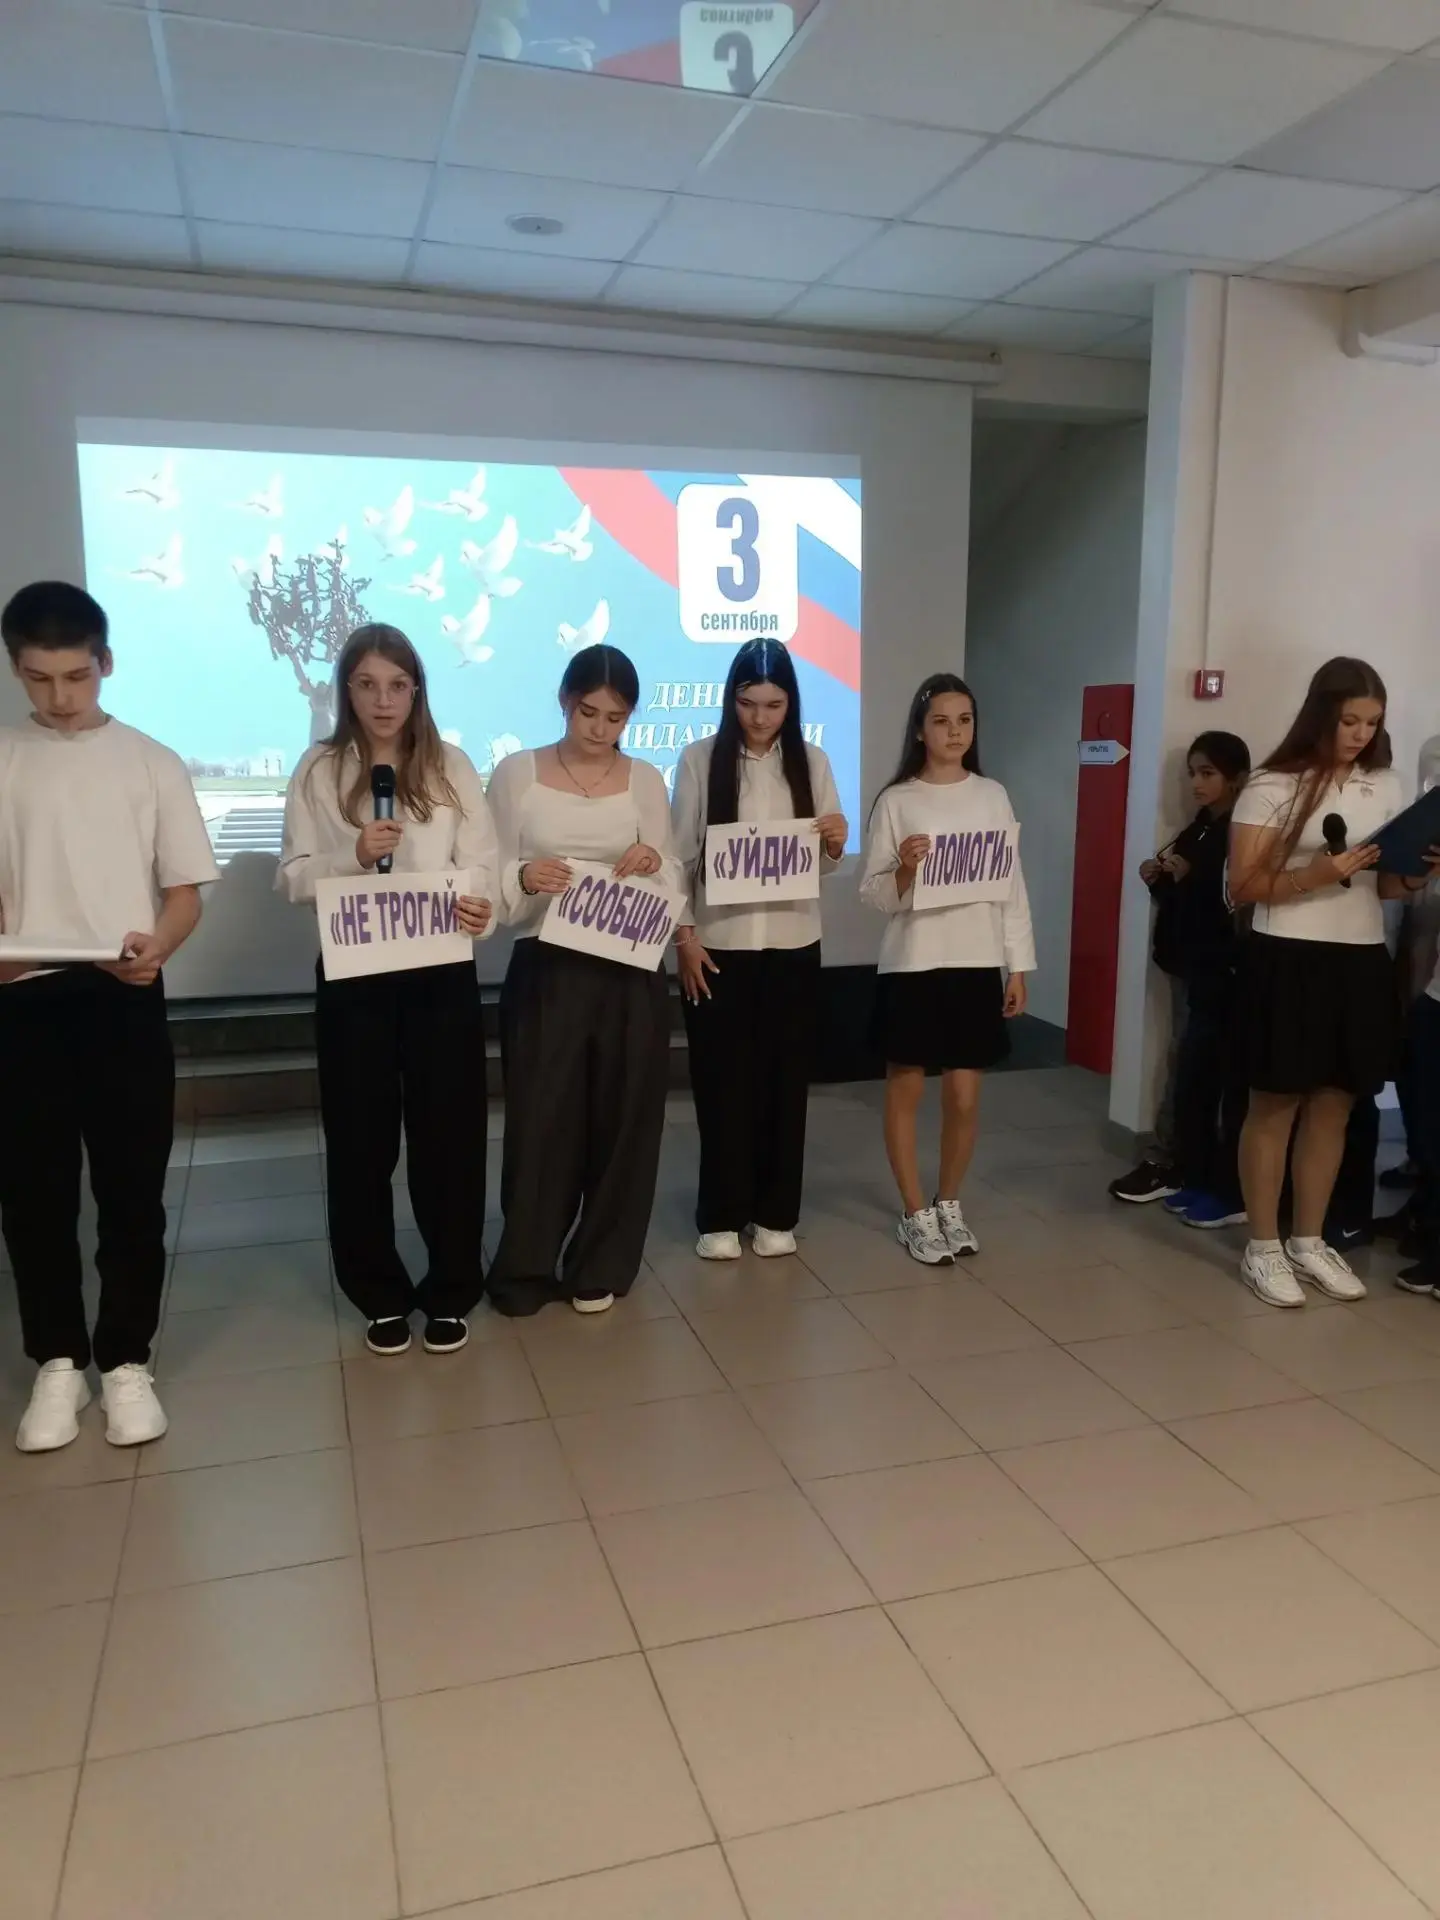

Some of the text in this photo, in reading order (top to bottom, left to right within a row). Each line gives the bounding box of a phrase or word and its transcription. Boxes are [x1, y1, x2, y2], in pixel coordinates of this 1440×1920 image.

[716, 497, 761, 602] 3
[700, 609, 779, 634] сентября
[713, 826, 813, 886] «УЙДИ»
[922, 830, 1013, 886] «ПОМОГИ»
[330, 893, 373, 946] «НЕ
[557, 874, 673, 952] «СООБЩИ»
